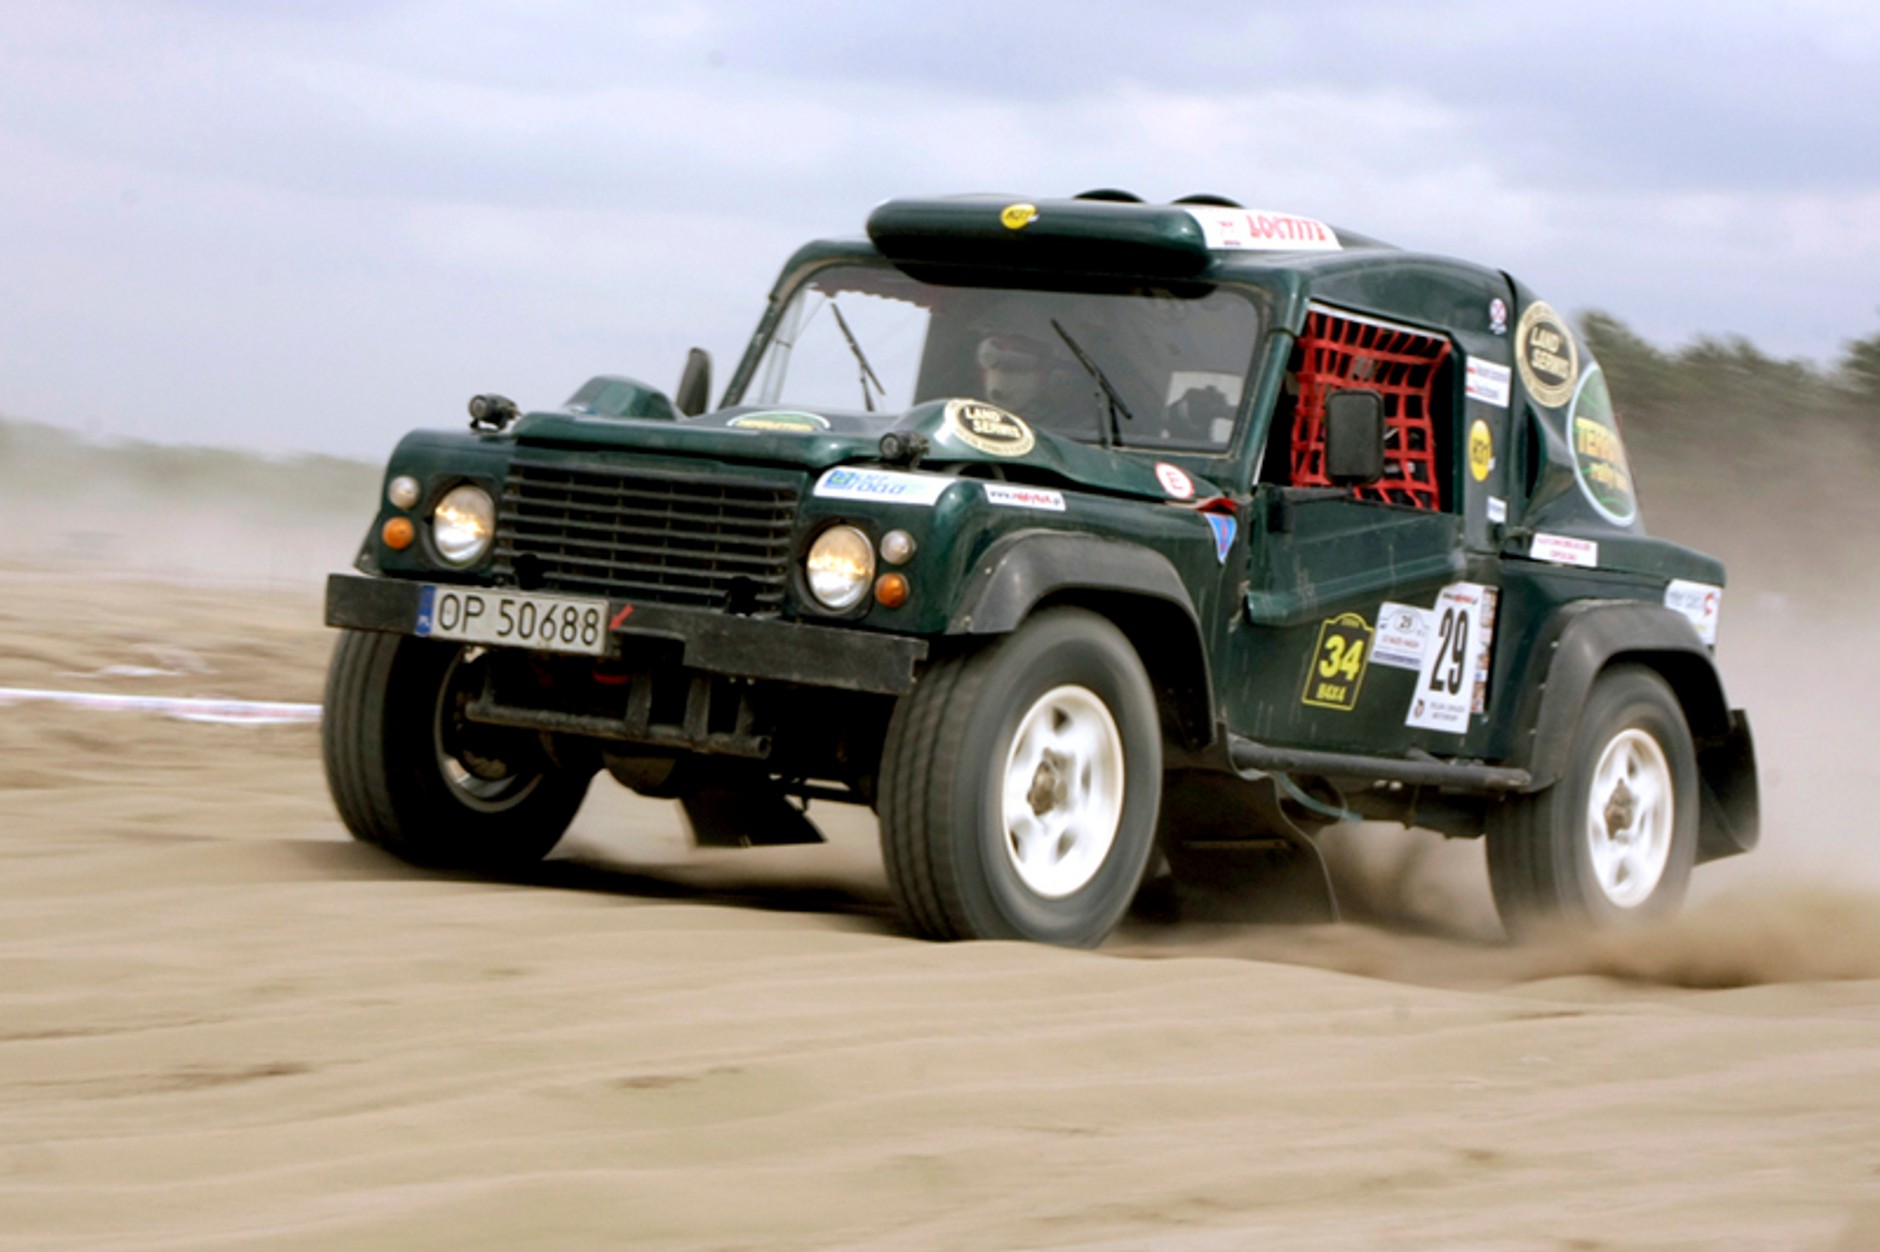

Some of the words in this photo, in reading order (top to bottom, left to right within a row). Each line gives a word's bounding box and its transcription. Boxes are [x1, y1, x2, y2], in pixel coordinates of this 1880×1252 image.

[964, 406, 1001, 421] LAND
[438, 594, 485, 633] OP
[496, 600, 599, 647] 50688
[1320, 634, 1363, 681] 34
[1429, 607, 1468, 695] 29
